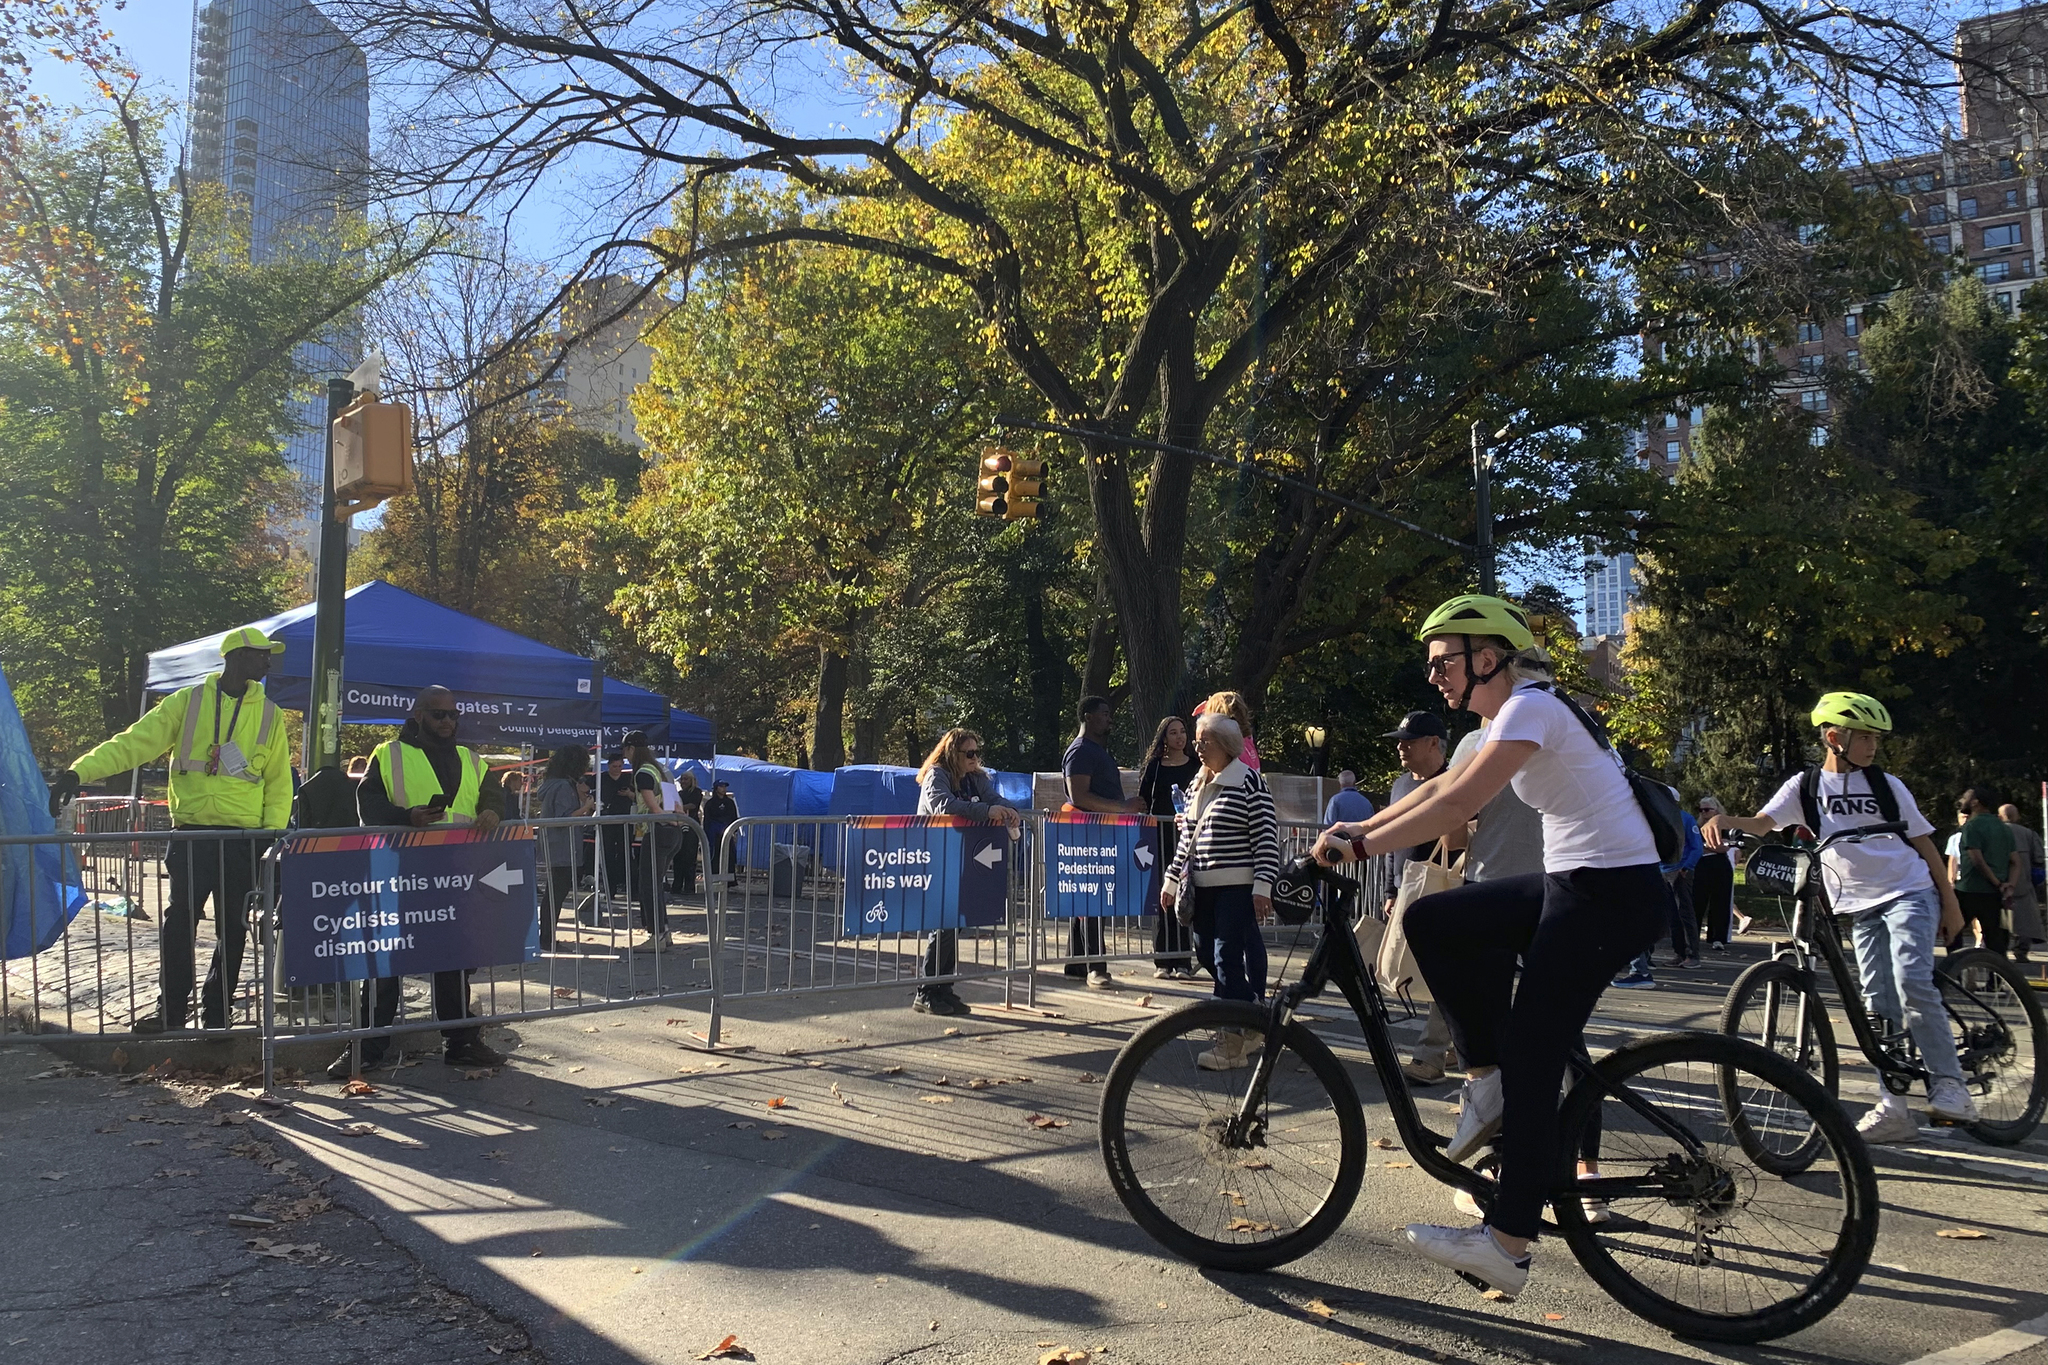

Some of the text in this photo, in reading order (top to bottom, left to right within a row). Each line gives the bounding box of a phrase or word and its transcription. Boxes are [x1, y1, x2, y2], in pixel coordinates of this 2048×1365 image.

[347, 689, 416, 712] Country
[455, 702, 500, 715] gates
[502, 702, 513, 715] T
[528, 703, 538, 717] Z
[547, 727, 597, 738] Delegate
[603, 726, 612, 736] K
[622, 726, 629, 736] S
[1817, 794, 1878, 815] VANS
[865, 847, 931, 869] Cyclists
[1057, 843, 1118, 857] Runners and
[1058, 861, 1116, 875] Pedestrians
[311, 873, 475, 899] Detour this way
[864, 872, 932, 891] this way
[1058, 879, 1099, 896] this way
[1280, 884, 1309, 898] U B
[312, 905, 457, 935] Cyclists must
[314, 933, 415, 958] dismount
[1110, 1140, 1131, 1190] KENDA
